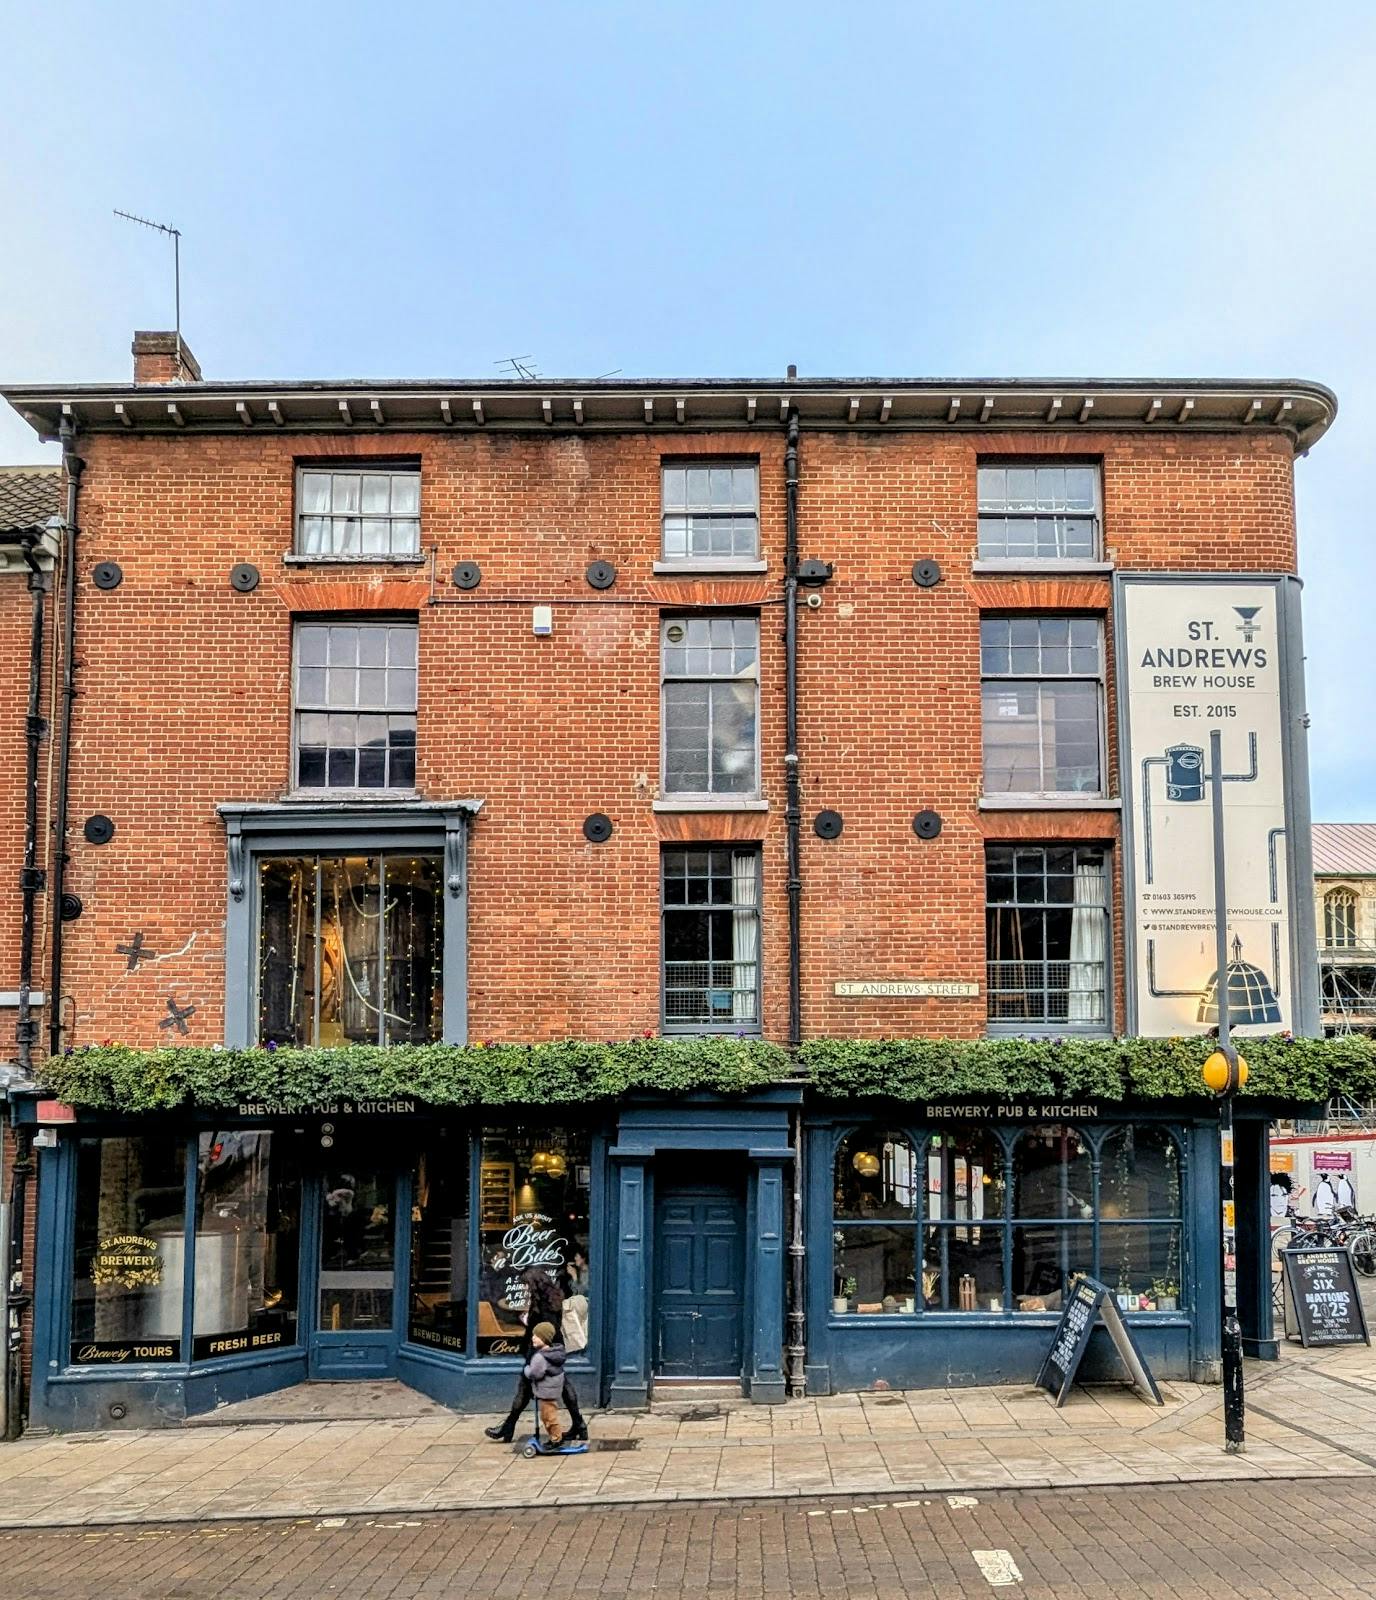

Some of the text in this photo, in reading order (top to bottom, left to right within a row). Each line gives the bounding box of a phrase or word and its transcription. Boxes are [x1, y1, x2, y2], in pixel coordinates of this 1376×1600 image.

[1188, 621, 1219, 641] ST.
[1141, 648, 1267, 668] ANDREWS
[1153, 676, 1255, 688] BREW HOUSE
[1174, 705, 1237, 718] EST. 2015
[840, 984, 972, 994] ST ANDREWS STREET
[312, 1102, 338, 1114] PUB
[343, 1102, 353, 1114] &
[357, 1101, 415, 1114] KITCHEN
[926, 1105, 1098, 1118] BREWERY, PUB & KITCHEN
[533, 1213, 552, 1223] ABOUT
[503, 1223, 556, 1249] Beer
[510, 1238, 568, 1270] Bites
[100, 1256, 157, 1266] BREWERY
[1313, 1279, 1335, 1290] SIX
[1305, 1291, 1350, 1303] NATIONS
[210, 1332, 281, 1353] FRESH BEER
[413, 1328, 462, 1348] BREWED HERE
[77, 1345, 173, 1362] Brewery TOURS
